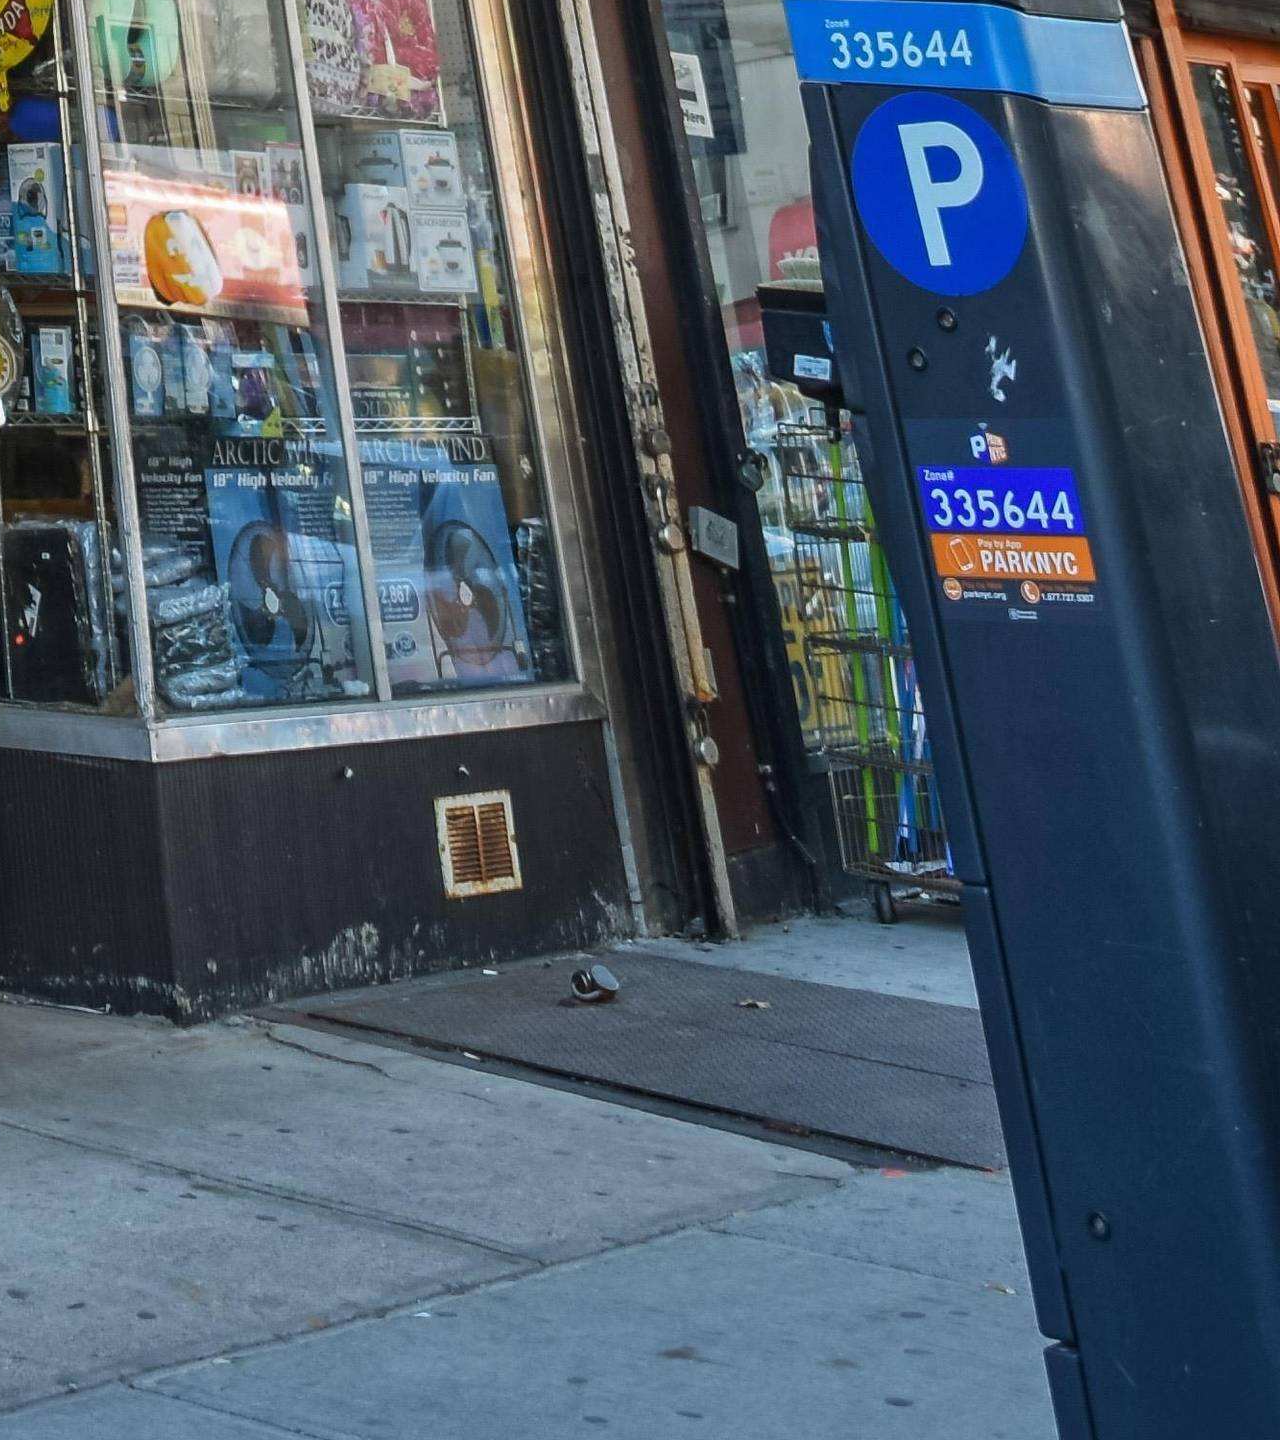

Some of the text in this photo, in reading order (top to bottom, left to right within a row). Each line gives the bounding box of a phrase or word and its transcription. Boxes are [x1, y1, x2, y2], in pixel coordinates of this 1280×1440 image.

[830, 29, 973, 69] 335644
[897, 120, 985, 267] P
[212, 439, 279, 465] ARCTIC
[361, 437, 486, 462] ARCTIC WIND
[184, 472, 202, 483] Fan
[237, 472, 268, 490] High
[271, 472, 318, 489] Velocity
[389, 470, 417, 486] High
[423, 469, 470, 486] Velocity
[473, 469, 496, 482] Fan
[930, 488, 1074, 529] 335644
[977, 538, 994, 549] Pay
[1006, 540, 1022, 550] App
[980, 550, 1079, 576] PARKNYC
